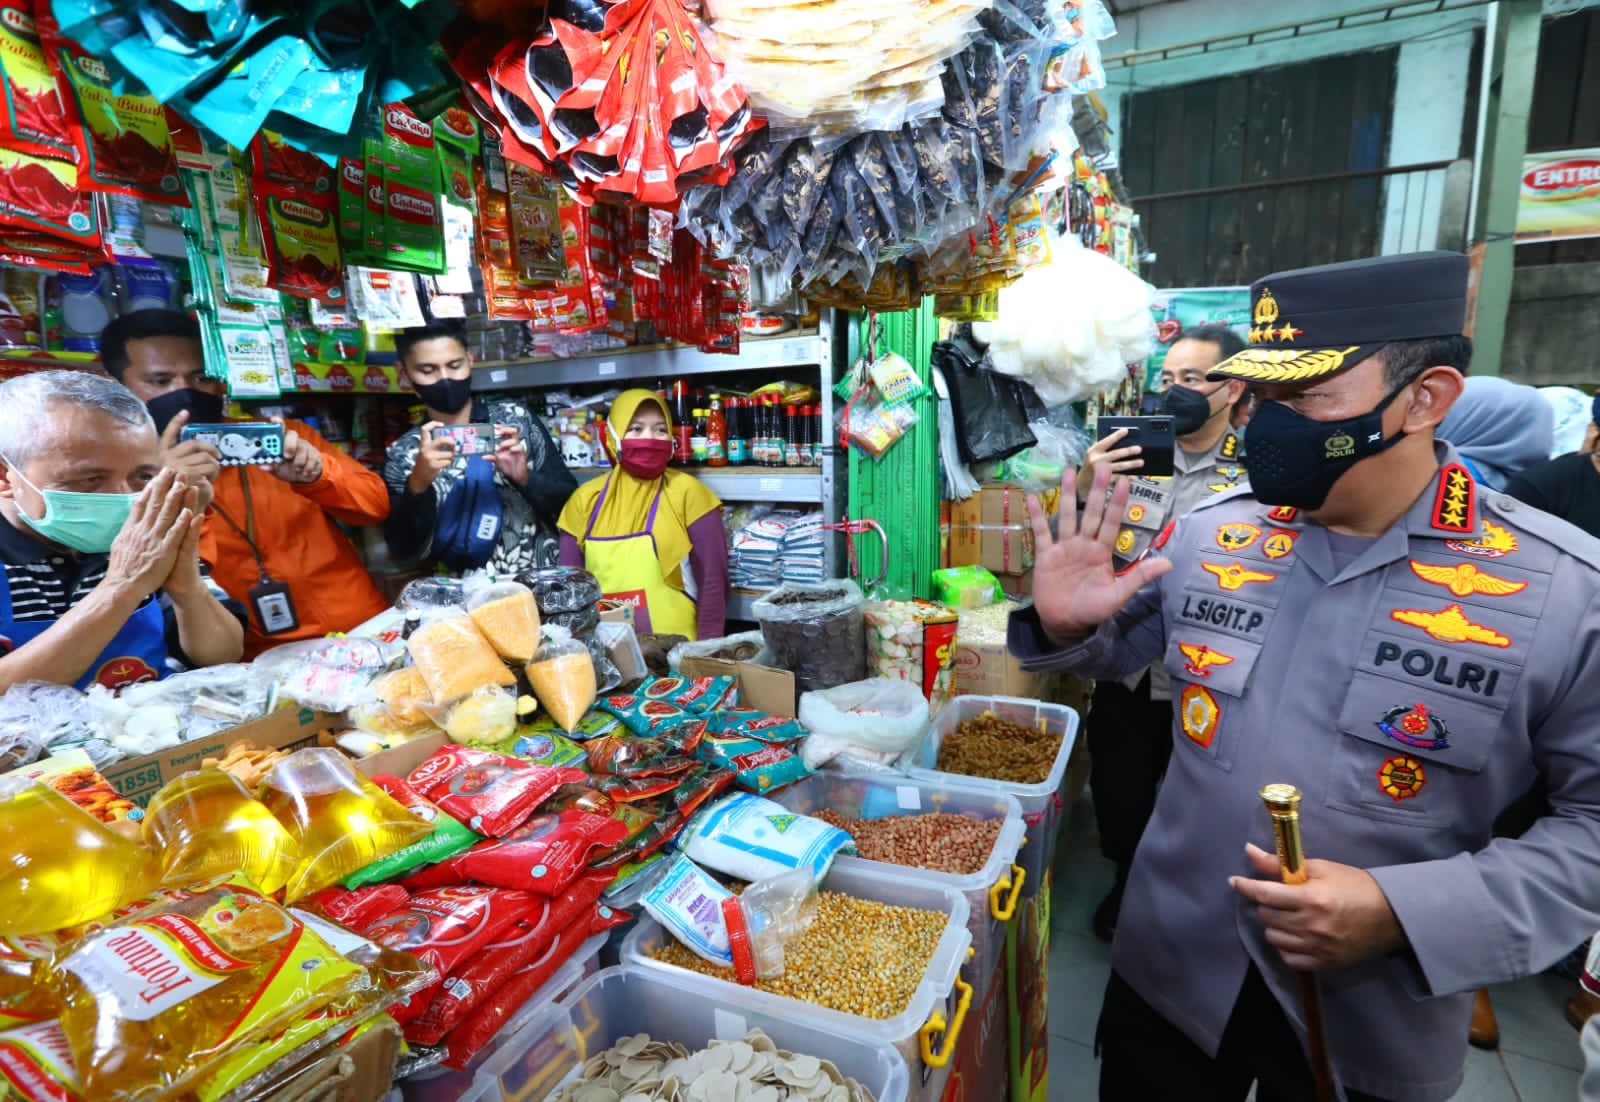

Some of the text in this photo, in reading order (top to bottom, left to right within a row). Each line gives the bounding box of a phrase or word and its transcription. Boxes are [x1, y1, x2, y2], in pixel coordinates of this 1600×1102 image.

[1325, 448, 1355, 459] POLRI
[1182, 595, 1263, 633] L.SIGIT.P
[1374, 641, 1500, 697] POLRI
[114, 767, 157, 794] 1858
[106, 930, 192, 1004] Fortune
